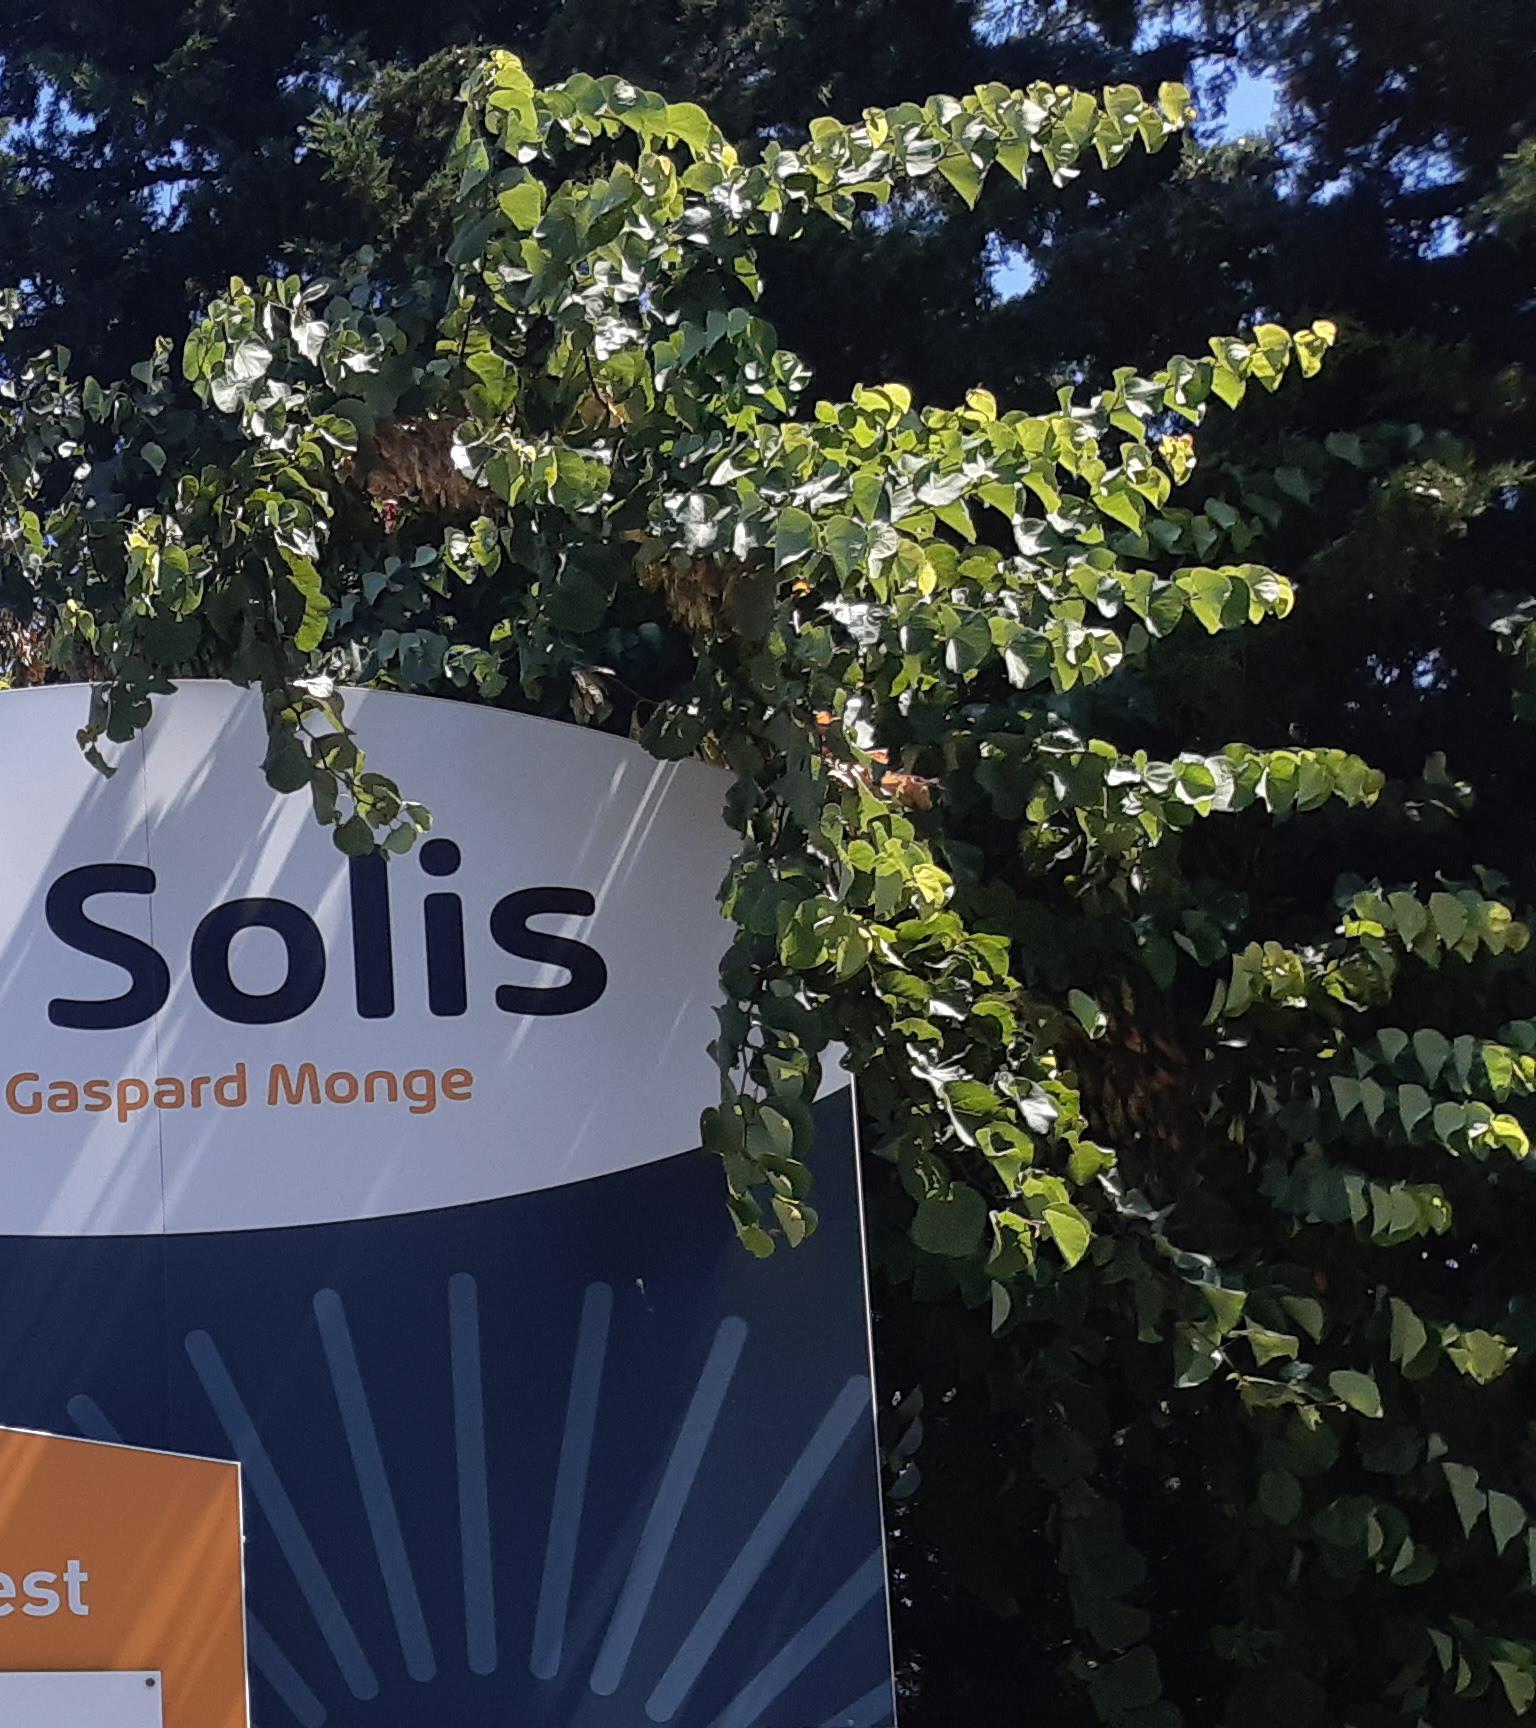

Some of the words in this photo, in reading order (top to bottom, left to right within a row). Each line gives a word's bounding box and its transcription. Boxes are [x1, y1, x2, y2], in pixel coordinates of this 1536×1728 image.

[44, 837, 610, 1031] Solis
[3, 1061, 249, 1124] Gaspard
[265, 1061, 475, 1117] Monge
